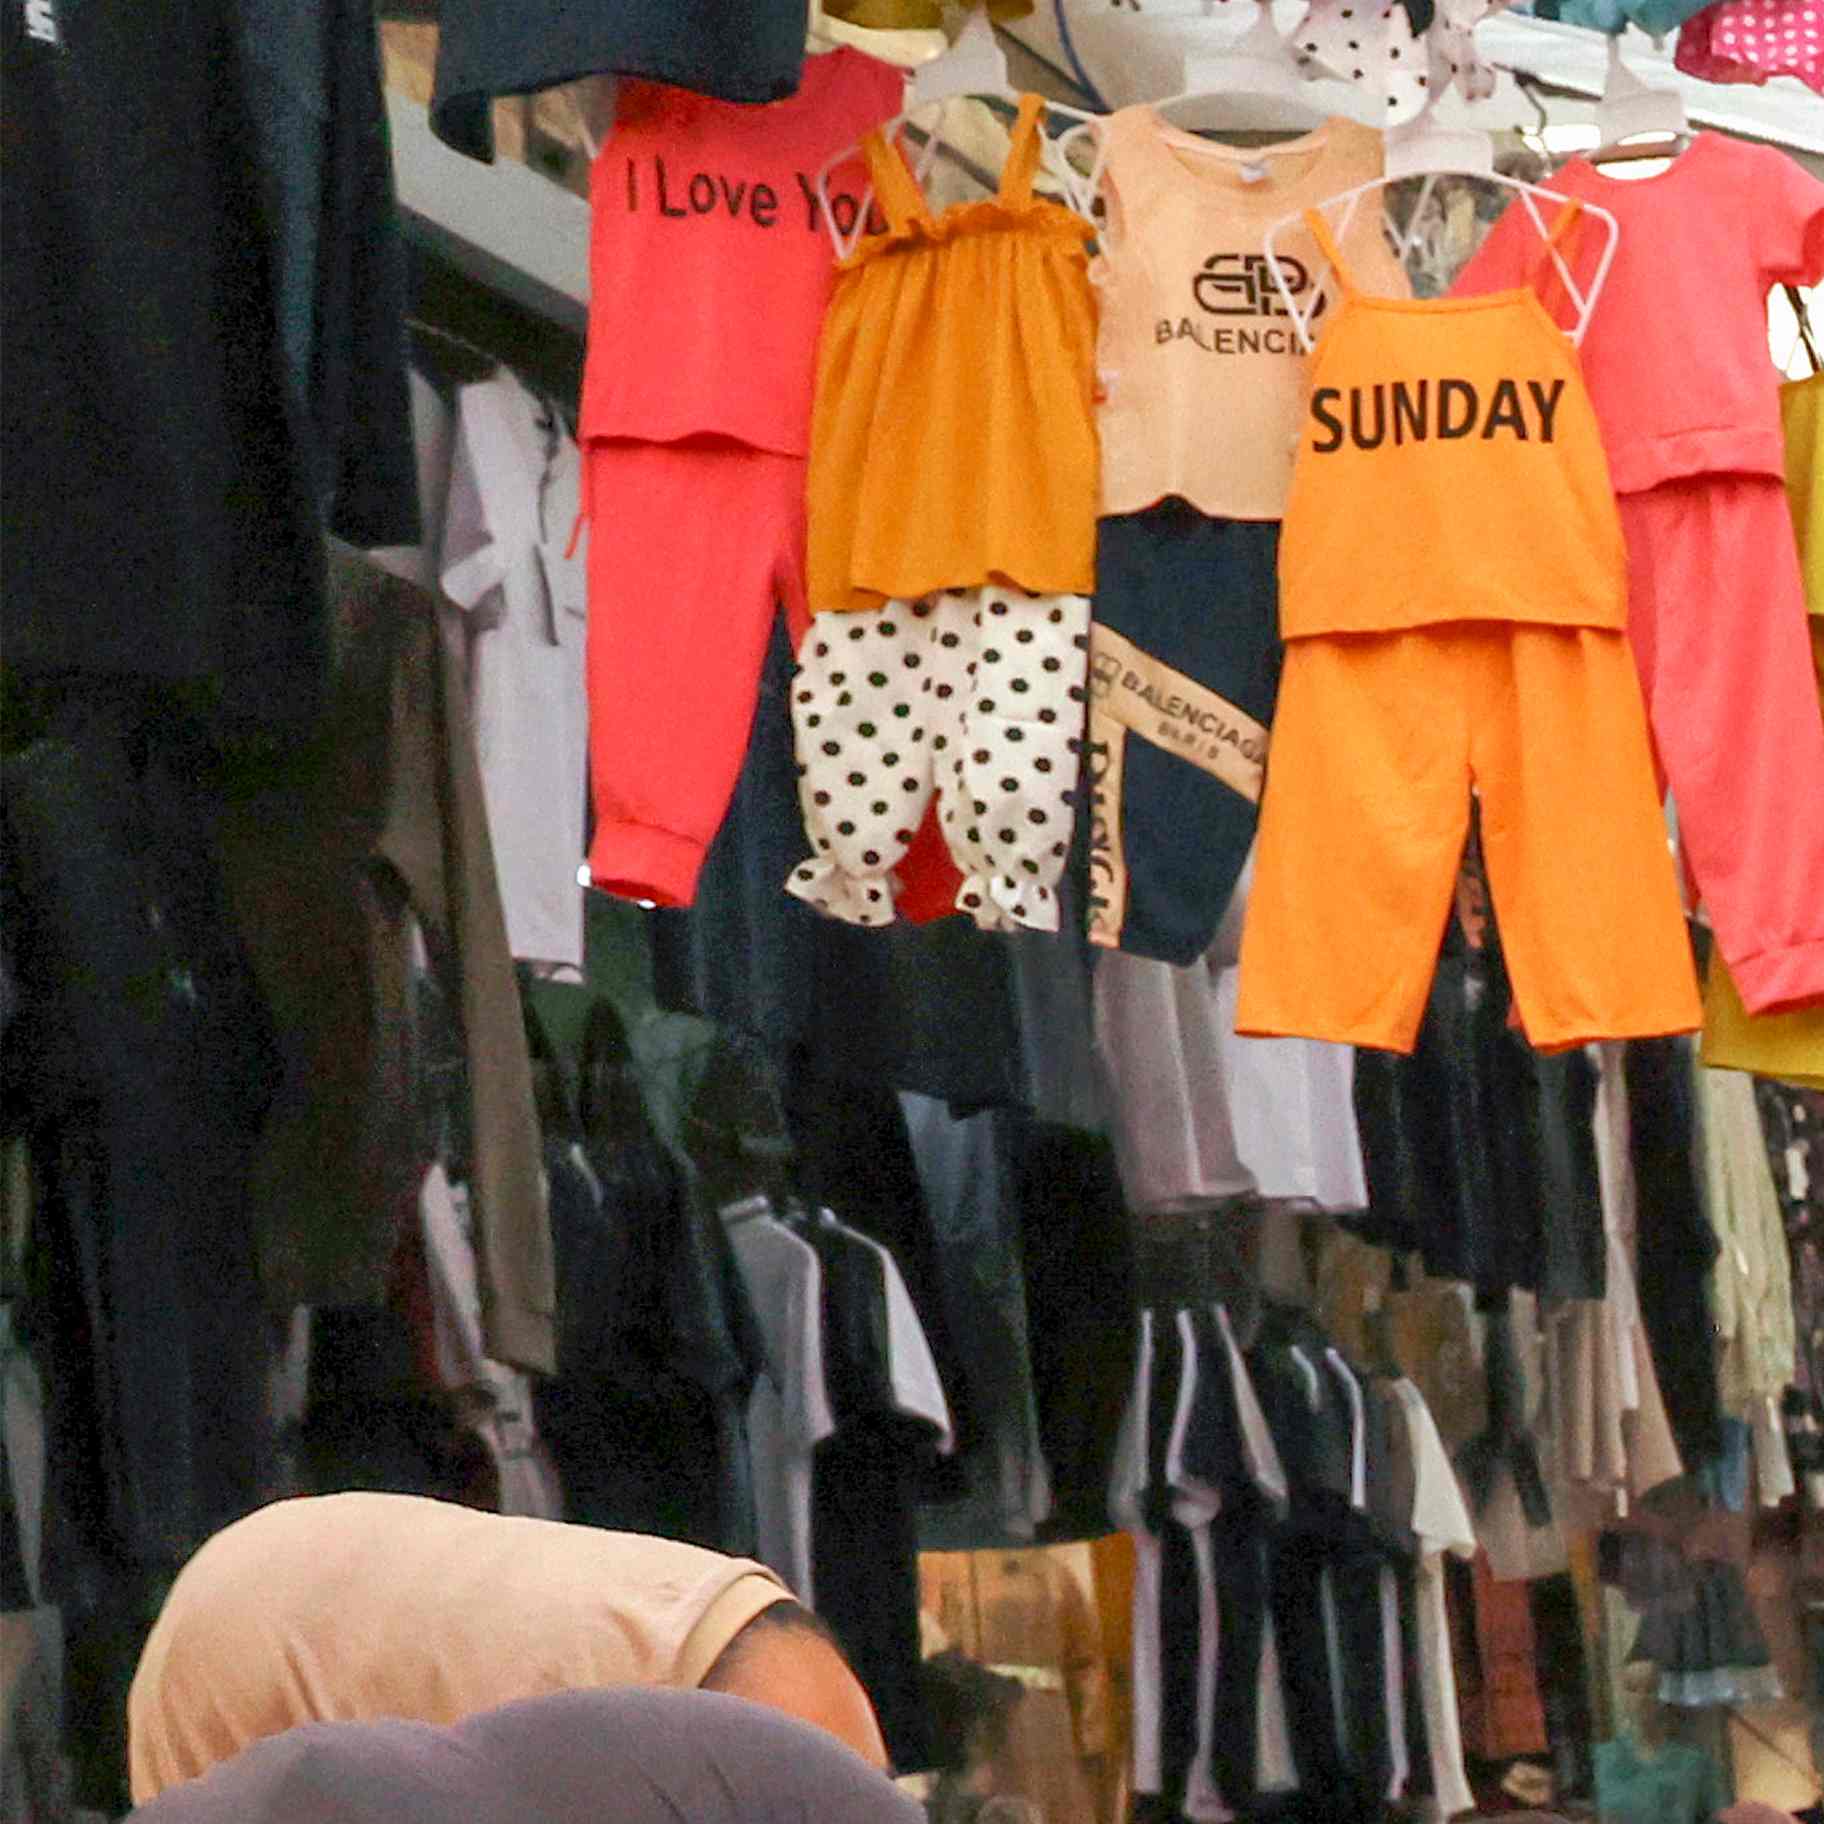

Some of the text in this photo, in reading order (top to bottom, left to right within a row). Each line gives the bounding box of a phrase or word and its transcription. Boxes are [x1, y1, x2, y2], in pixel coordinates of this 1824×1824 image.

[626, 157, 639, 212] I
[655, 154, 778, 227] Love
[1310, 379, 1565, 453] SUNDAY
